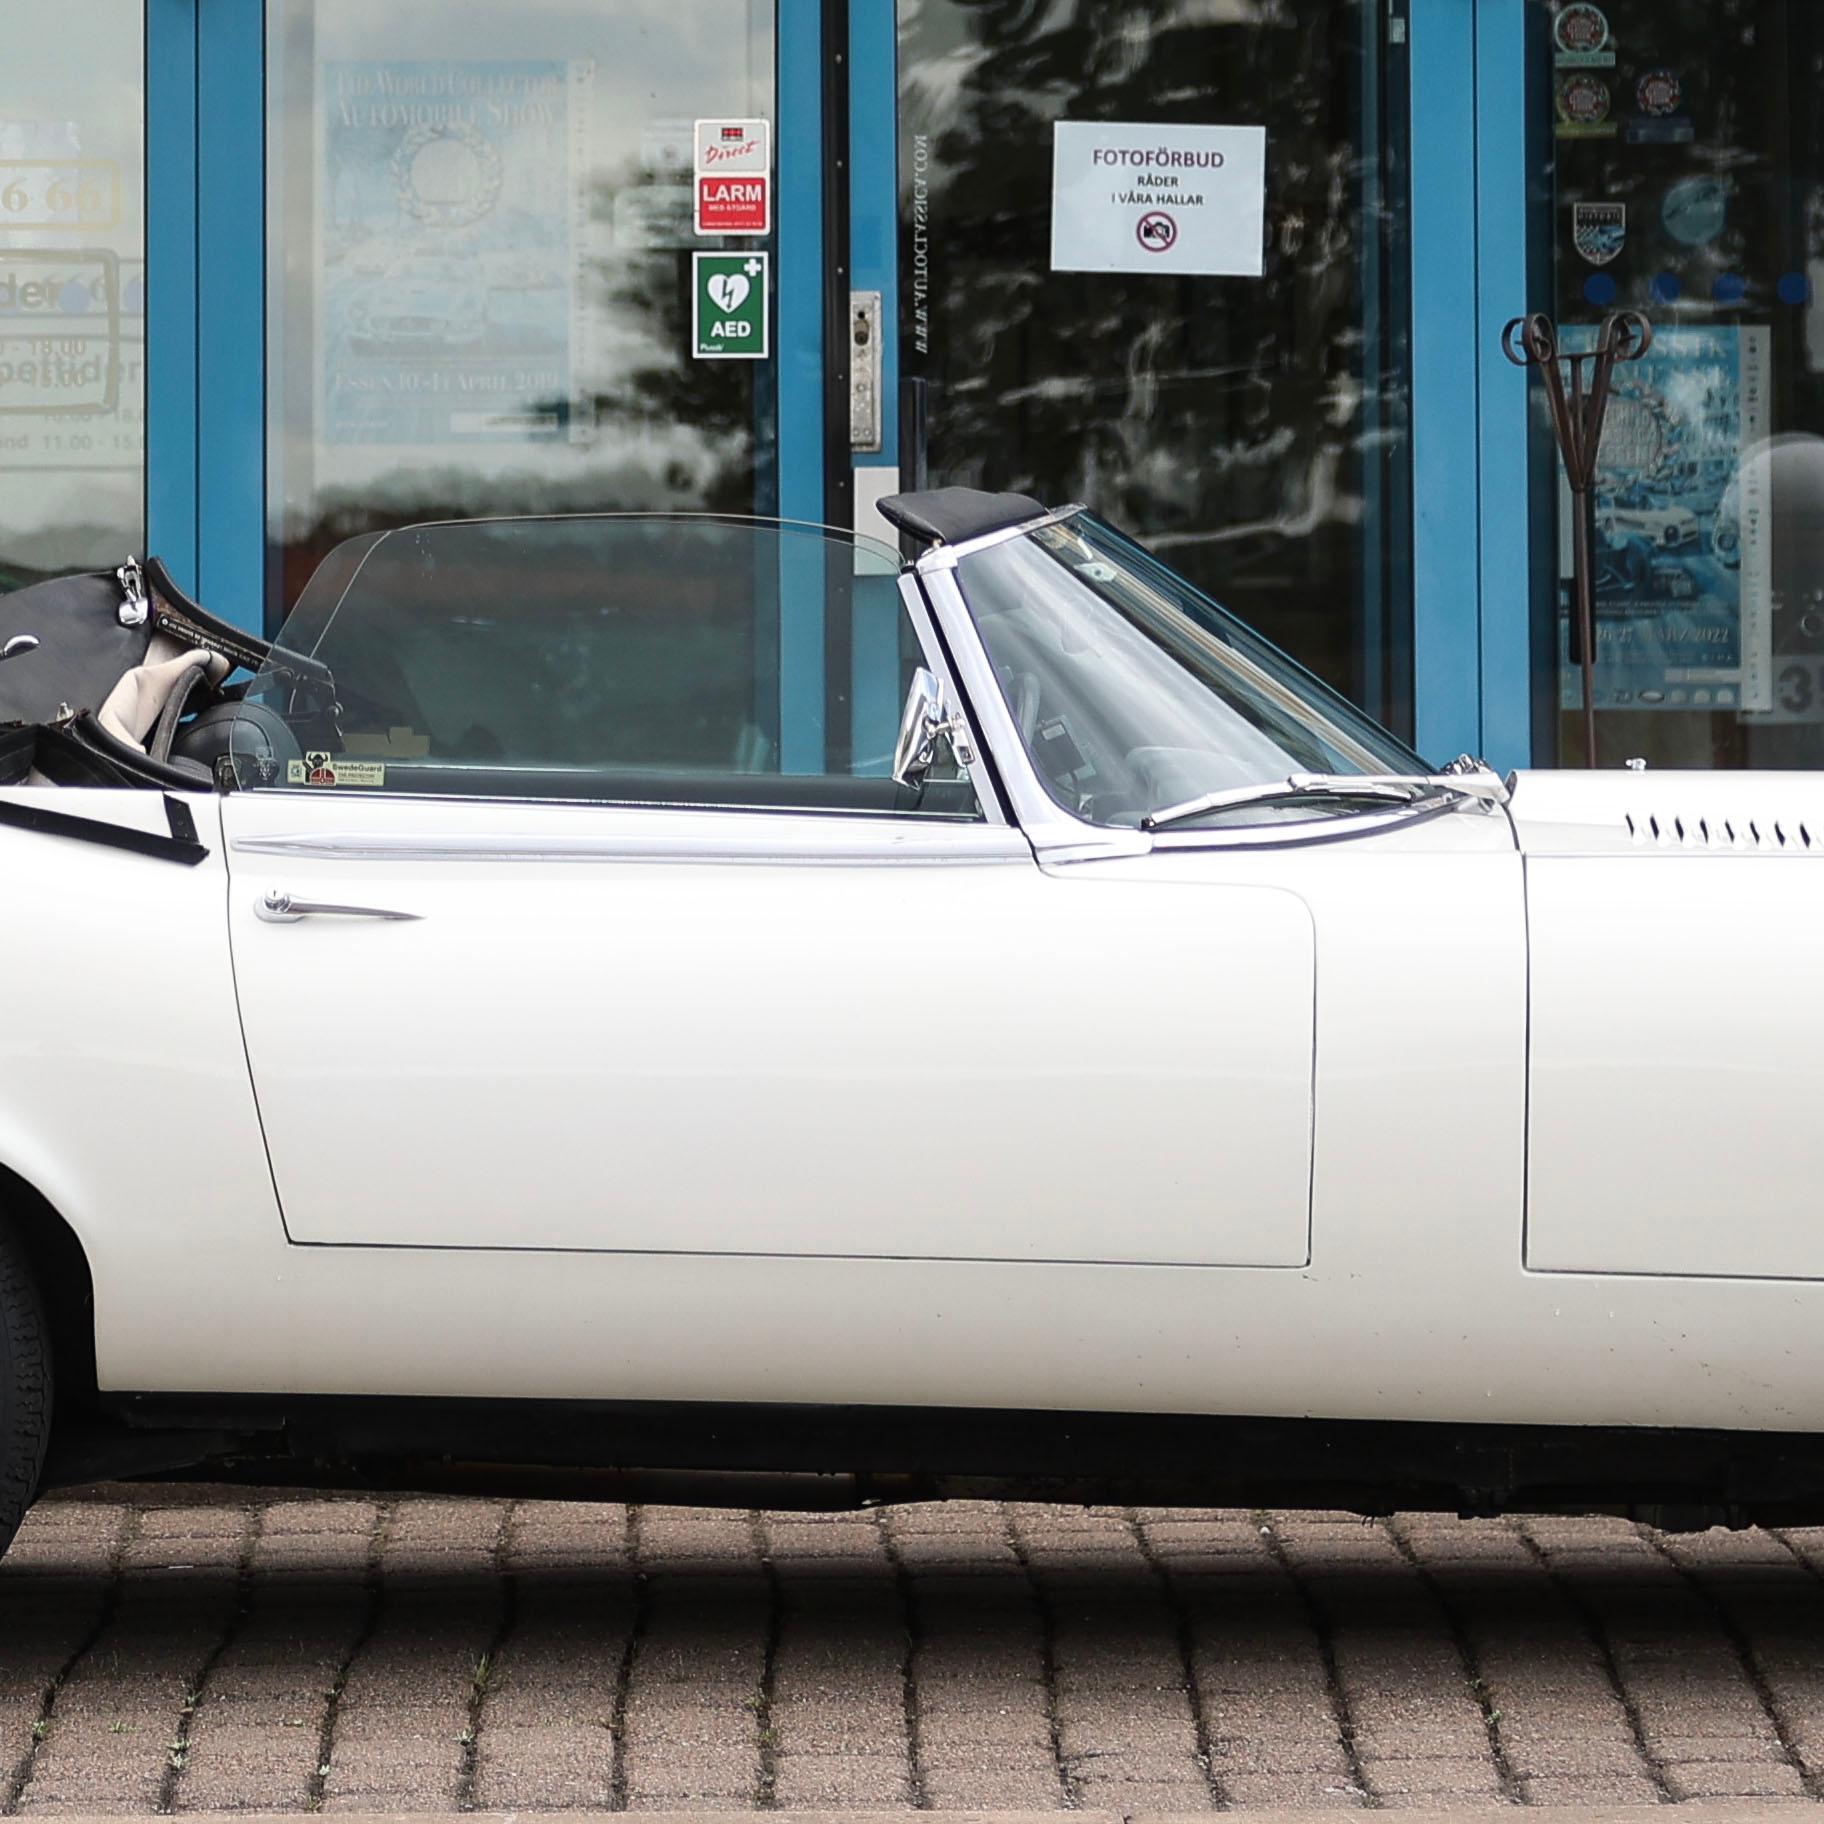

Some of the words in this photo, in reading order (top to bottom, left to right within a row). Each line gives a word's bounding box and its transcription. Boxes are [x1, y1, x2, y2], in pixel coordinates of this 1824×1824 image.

[1092, 147, 1224, 169] FOTOFÖRBUD
[1137, 173, 1179, 188] RÅDER
[44, 176, 105, 213] 66
[702, 184, 762, 202] LARM
[1119, 190, 1153, 205] VÅRA
[1156, 194, 1204, 206] HALLAR
[710, 320, 752, 338] AED
